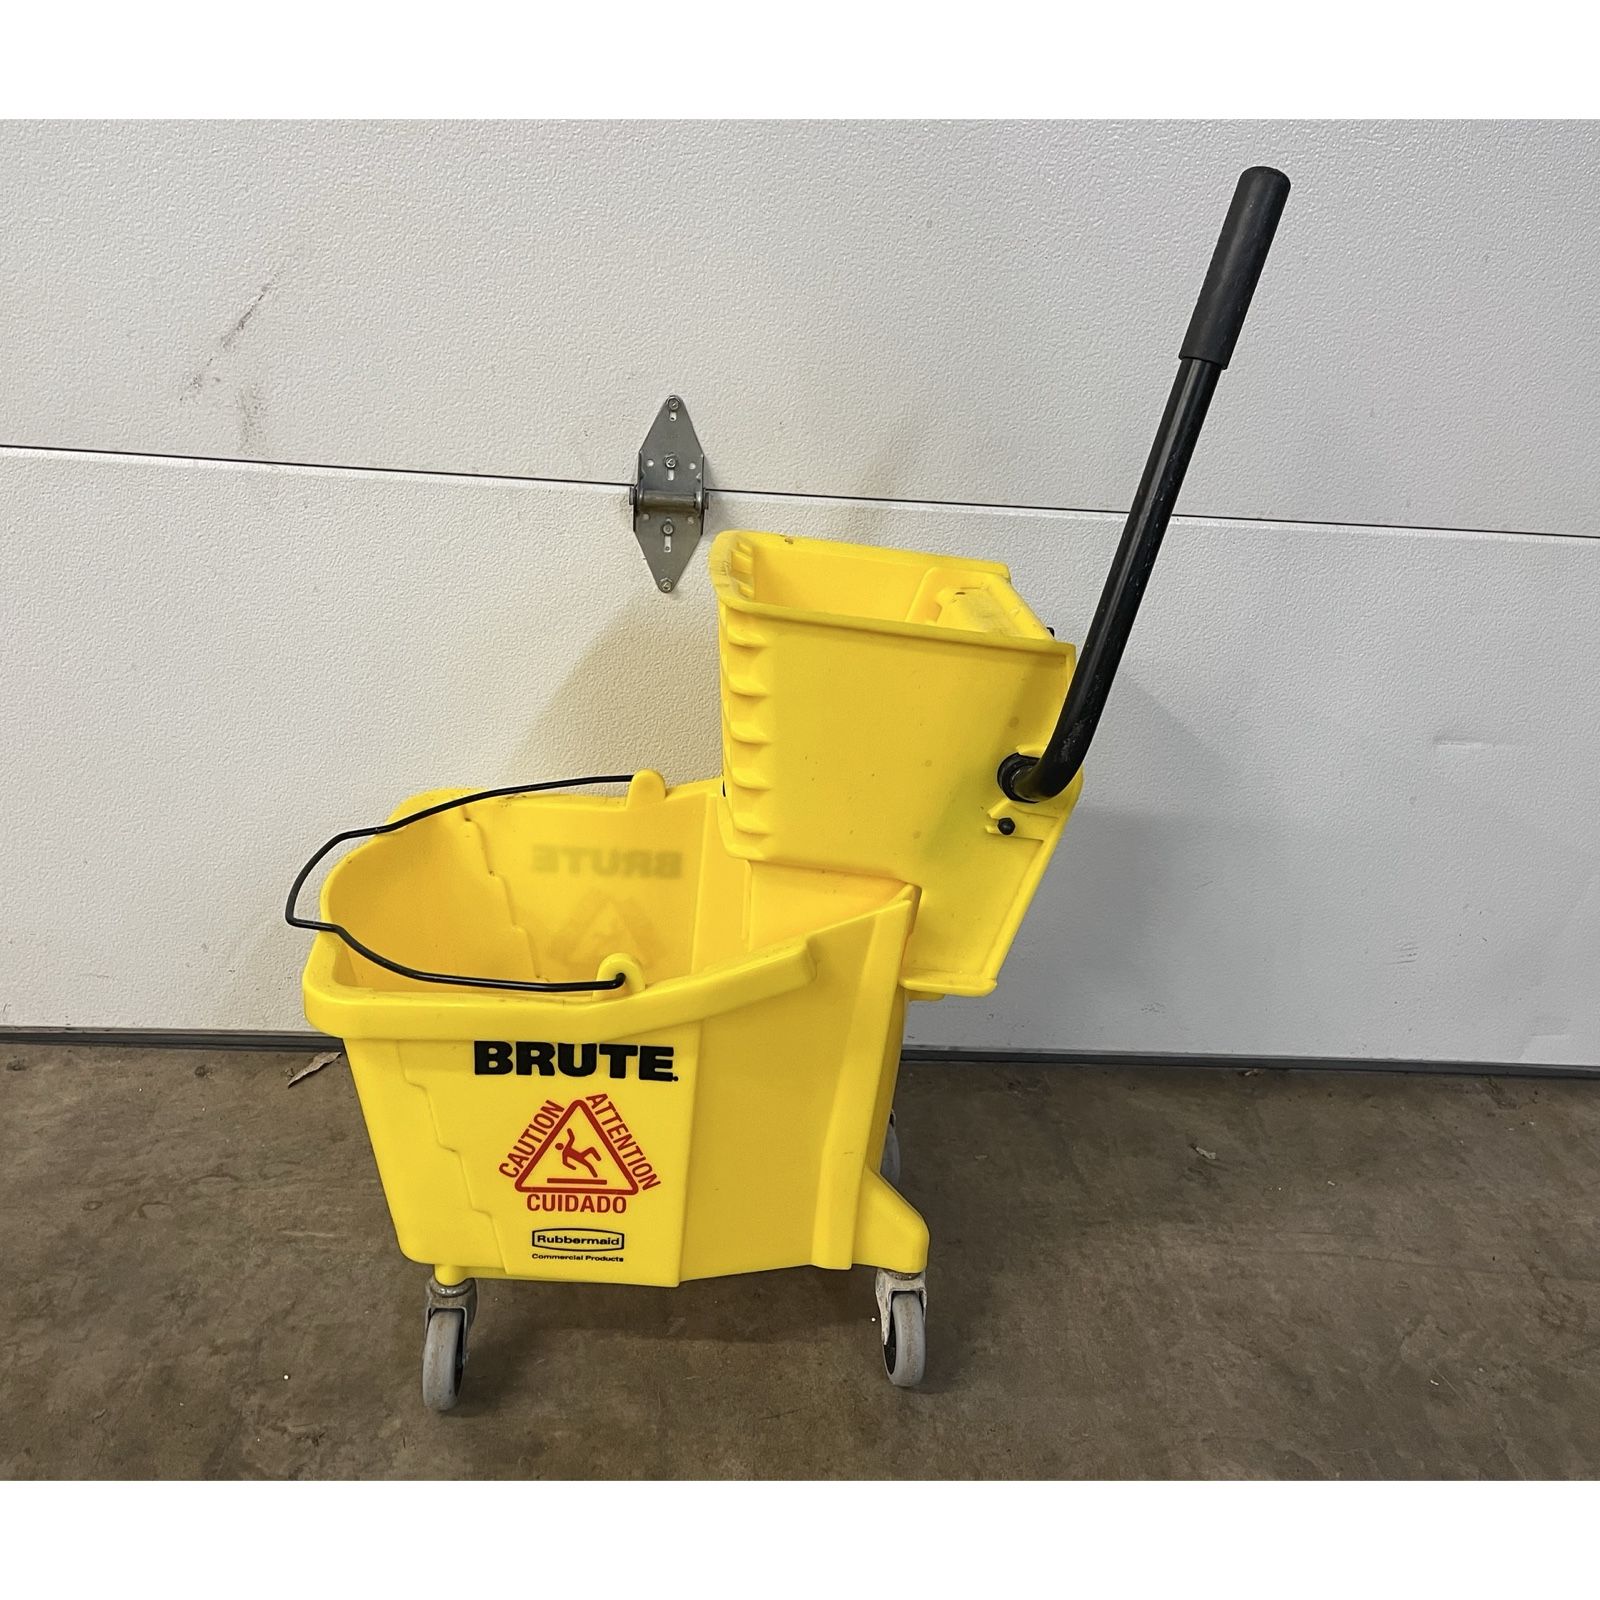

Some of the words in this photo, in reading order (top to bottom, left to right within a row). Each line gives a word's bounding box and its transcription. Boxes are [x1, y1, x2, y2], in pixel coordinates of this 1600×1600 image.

[499, 1099, 565, 1178] CAUTION
[585, 1093, 661, 1191] ATTENTION
[526, 1194, 627, 1214] CUIDADO
[537, 1235, 620, 1246] Rubbermaid
[531, 1253, 584, 1261] Commercial
